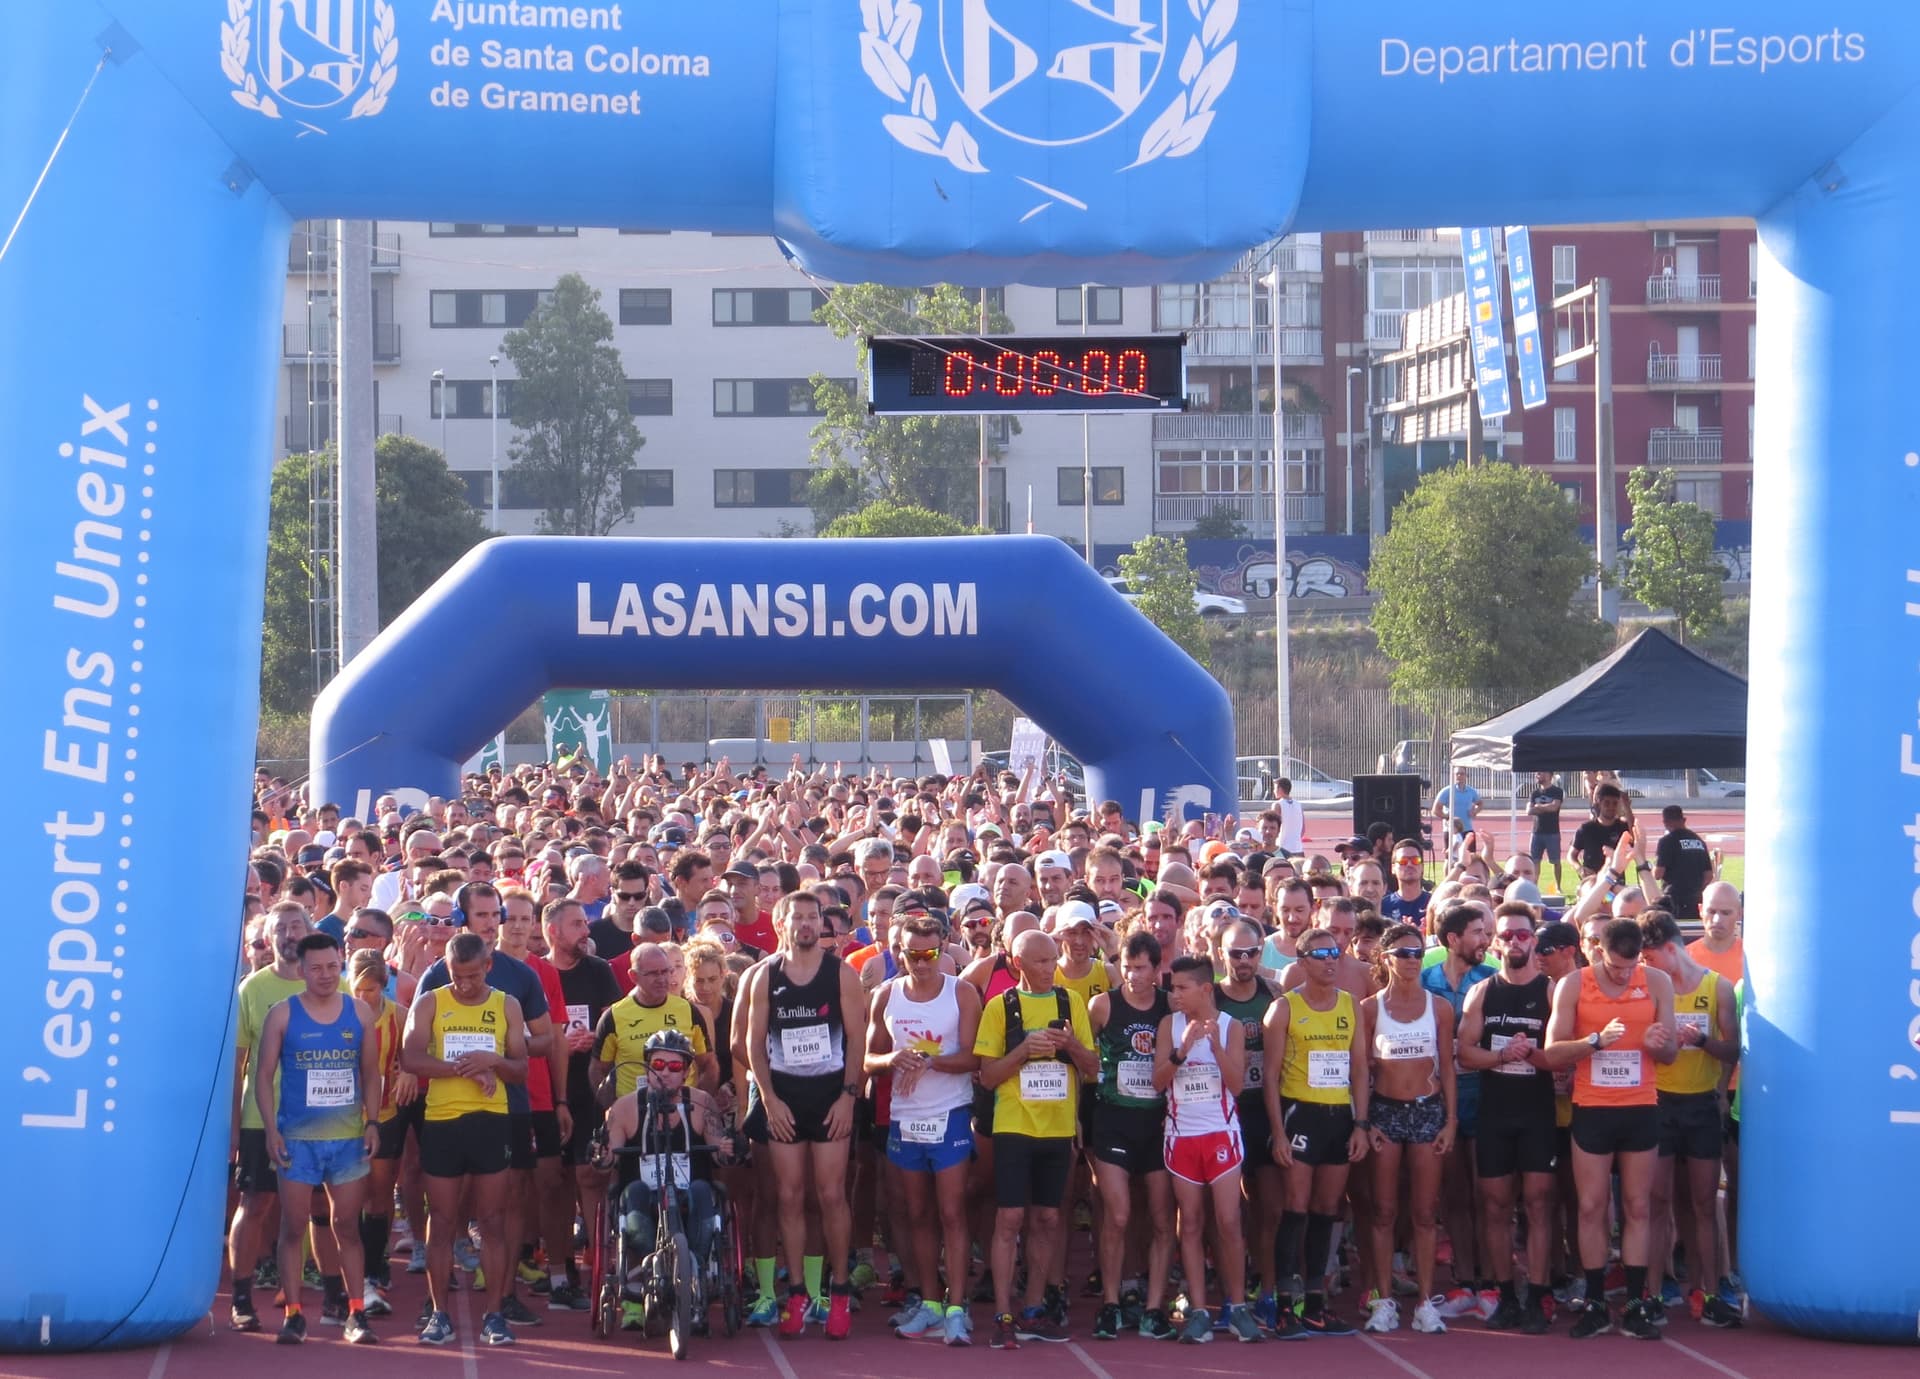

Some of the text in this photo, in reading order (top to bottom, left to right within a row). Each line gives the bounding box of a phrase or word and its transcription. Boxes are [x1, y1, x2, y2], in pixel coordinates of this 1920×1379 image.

[430, 0, 622, 32] Ajuntament
[430, 38, 710, 77] de Santa Coloma
[1380, 27, 1866, 84] Departament d'Esports
[430, 80, 641, 115] de Gramenet
[576, 582, 979, 638] LASANSI.COM
[22, 394, 131, 1130] L'esport Ens Uneix
[481, 1010, 496, 1023] LS
[1336, 1016, 1349, 1029] LS
[792, 1042, 820, 1054] PEDRO
[1390, 1046, 1425, 1055] MONTSE
[1323, 1068, 1340, 1076] IVAN
[1601, 1067, 1630, 1076] RUBEN
[1027, 1079, 1062, 1088] ANTONIO
[1184, 1082, 1209, 1092] NABIL
[910, 1122, 937, 1133] OSCAR
[1290, 1133, 1309, 1150] LS
